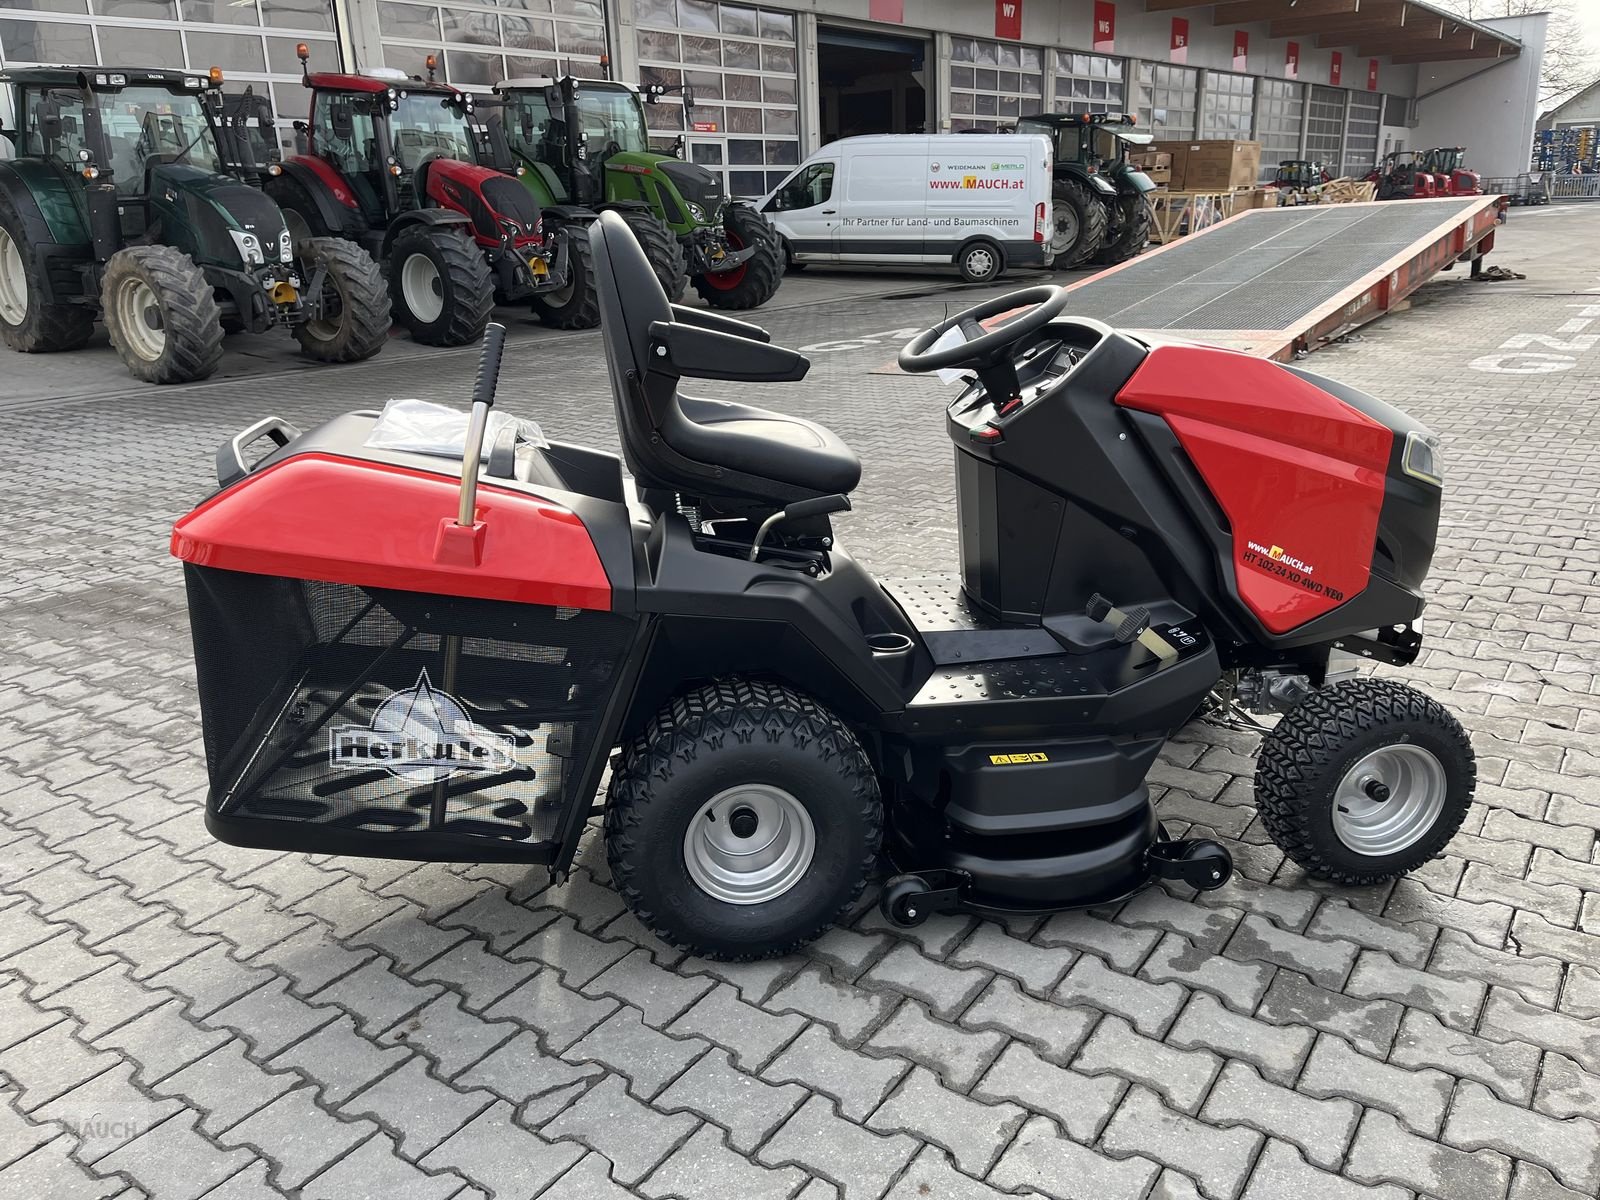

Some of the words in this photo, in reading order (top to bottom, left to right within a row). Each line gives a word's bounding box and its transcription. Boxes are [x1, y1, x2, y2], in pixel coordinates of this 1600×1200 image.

[1002, 3, 1016, 18] W7
[1098, 20, 1110, 34] W6
[930, 179, 1024, 190] www.MAUCH.at
[842, 217, 854, 226] Ihr
[857, 218, 889, 226] Partner
[891, 217, 905, 226] für
[906, 218, 932, 226] Land-
[933, 218, 951, 226] und
[954, 217, 1019, 226] Baumaschinen
[1247, 541, 1314, 574] www.MAUCH.at
[1243, 551, 1257, 563] HT
[1257, 558, 1286, 577] 102-24
[1286, 571, 1301, 583] XD
[1301, 578, 1323, 593] 4WD
[1323, 586, 1344, 601] NEO
